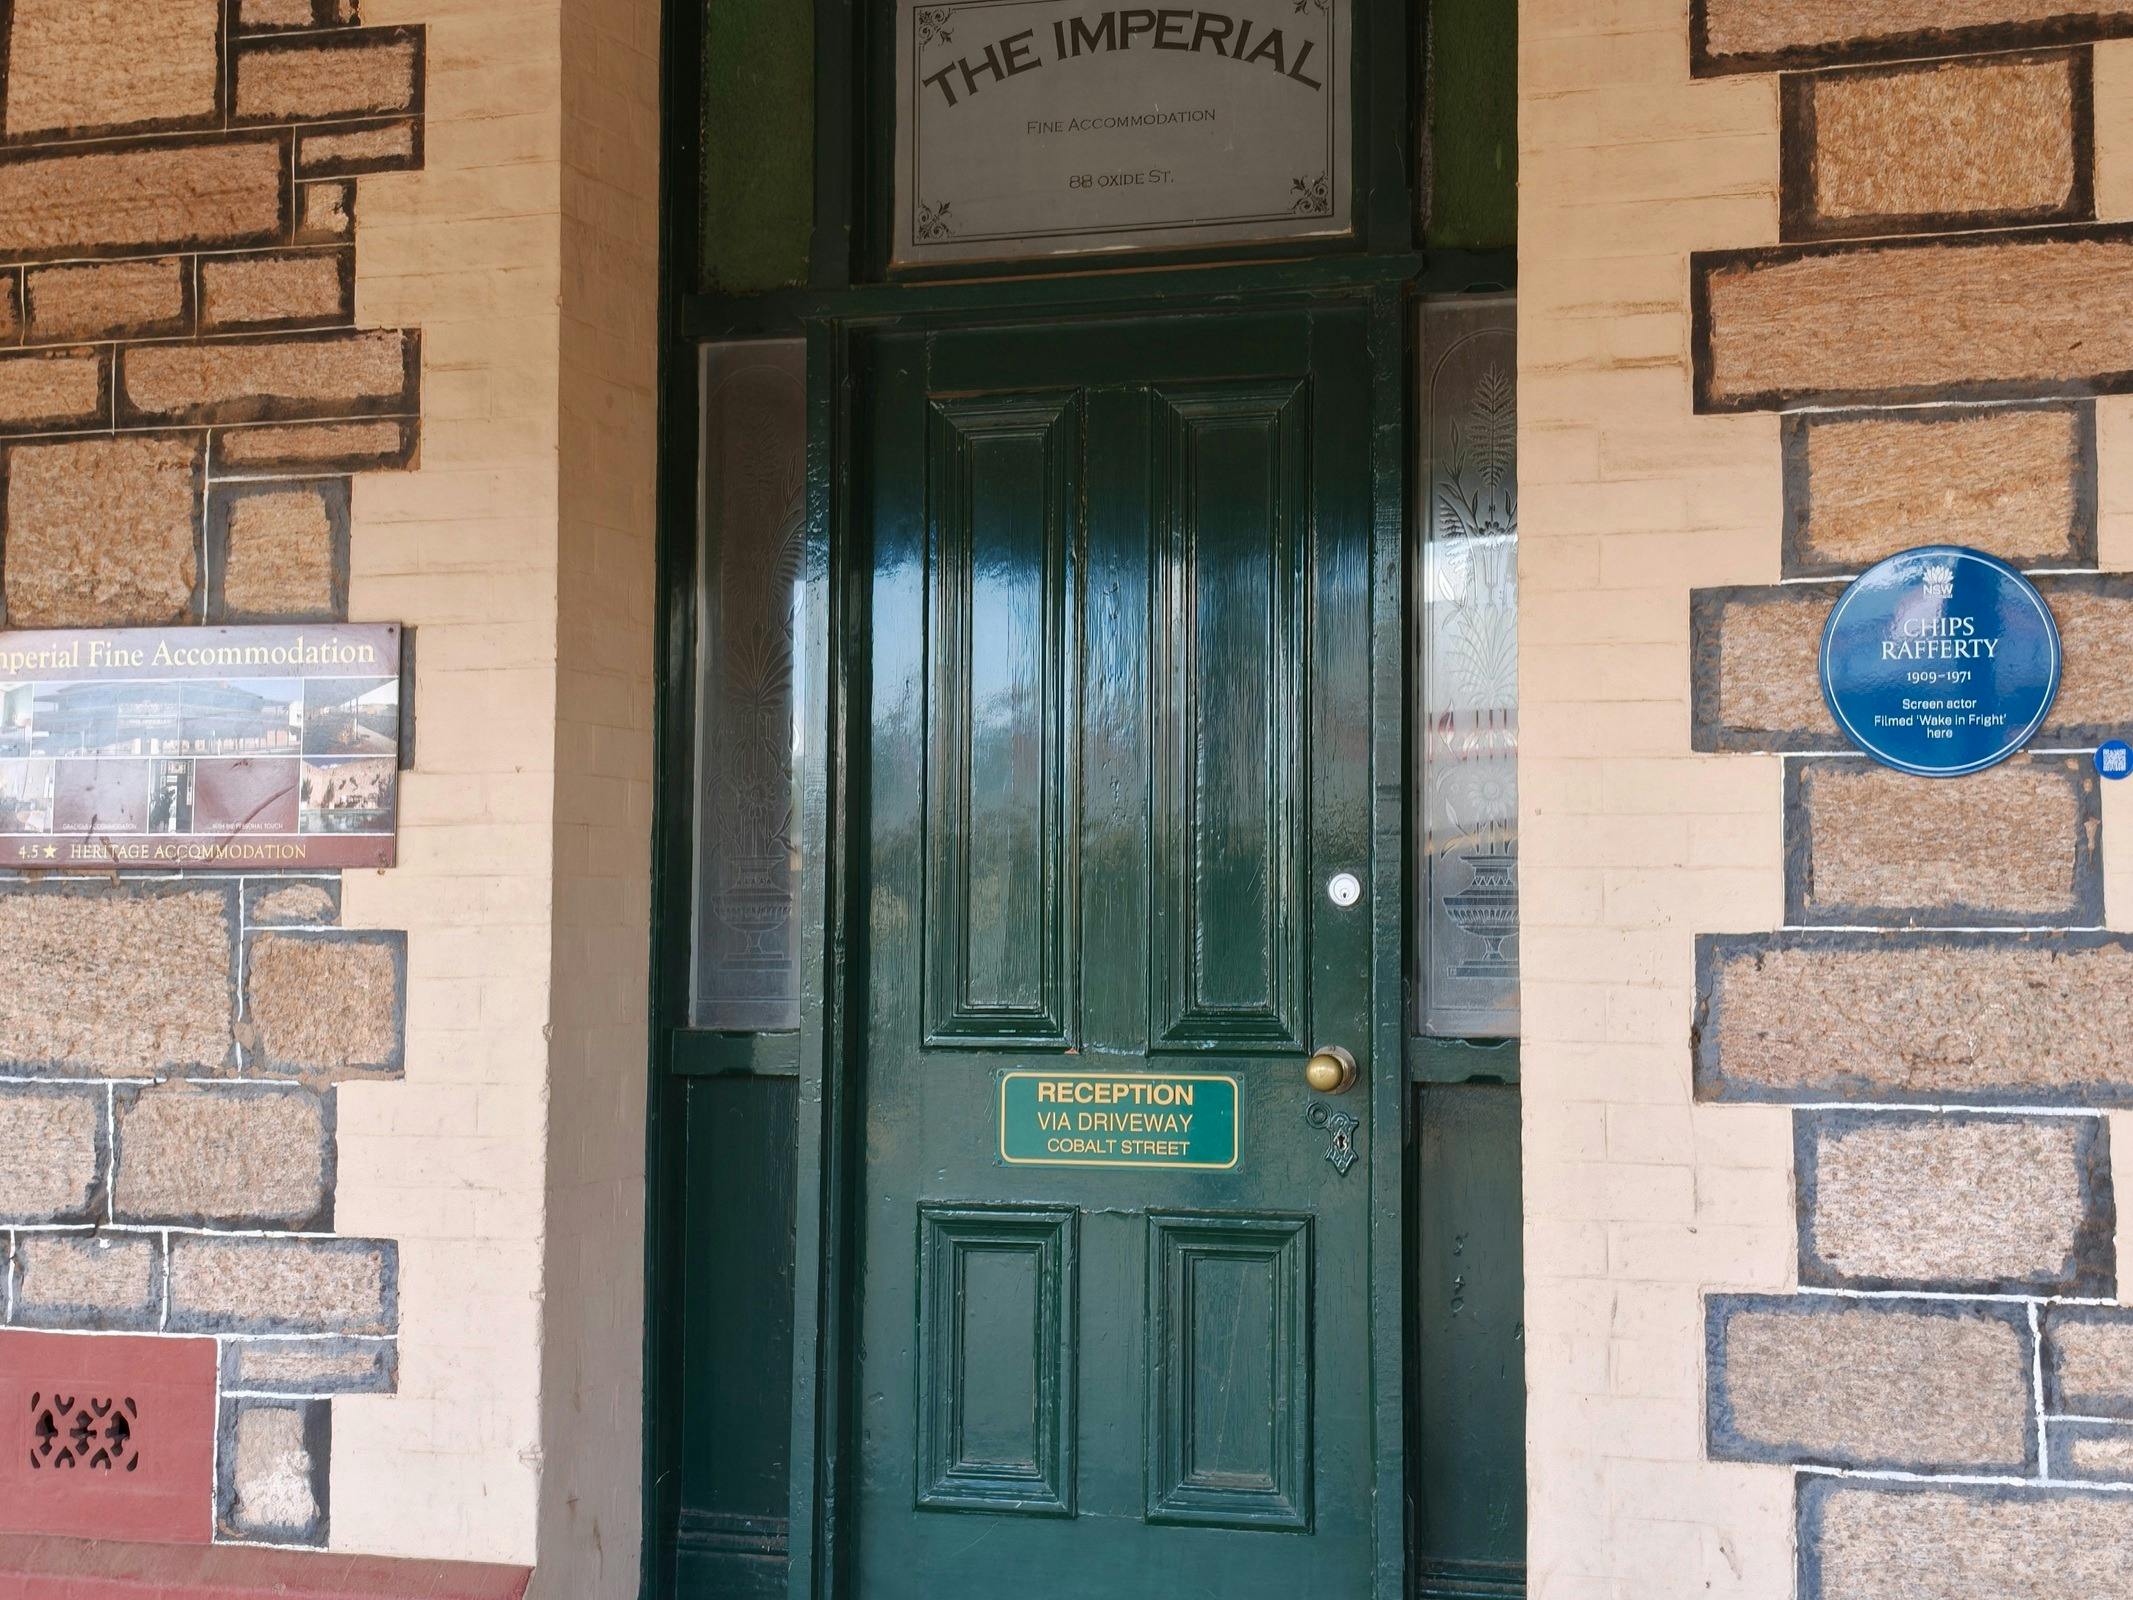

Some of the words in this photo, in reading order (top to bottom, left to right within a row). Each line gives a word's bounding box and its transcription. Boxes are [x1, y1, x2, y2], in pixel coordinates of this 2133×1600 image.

[922, 29, 1042, 107] THE
[1053, 9, 1322, 91] IMPERIAL
[1069, 174, 1093, 189] 88
[1097, 172, 1144, 188] OXIDE
[1923, 583, 1953, 595] NSW
[1903, 617, 1975, 637] CHIPS
[88, 639, 144, 668] Fine
[152, 637, 375, 667] Accommodation
[1882, 638, 1999, 660] RAFFERTY
[1902, 698, 1944, 710] Screen
[1946, 699, 1977, 709] actor
[1874, 715, 1914, 727] Filmed
[1955, 715, 1966, 726] in
[1926, 727, 1953, 738] here
[18, 843, 39, 860] 4.5
[71, 843, 149, 859] HERITAGE
[154, 843, 306, 861] ACCOMMODATION
[1037, 1082, 1193, 1105] RECEPTION
[1037, 1112, 1071, 1130] VIA
[1079, 1112, 1193, 1132] DRIVEWAY
[1047, 1138, 1116, 1153] COBALT
[1121, 1139, 1190, 1155] STREET
